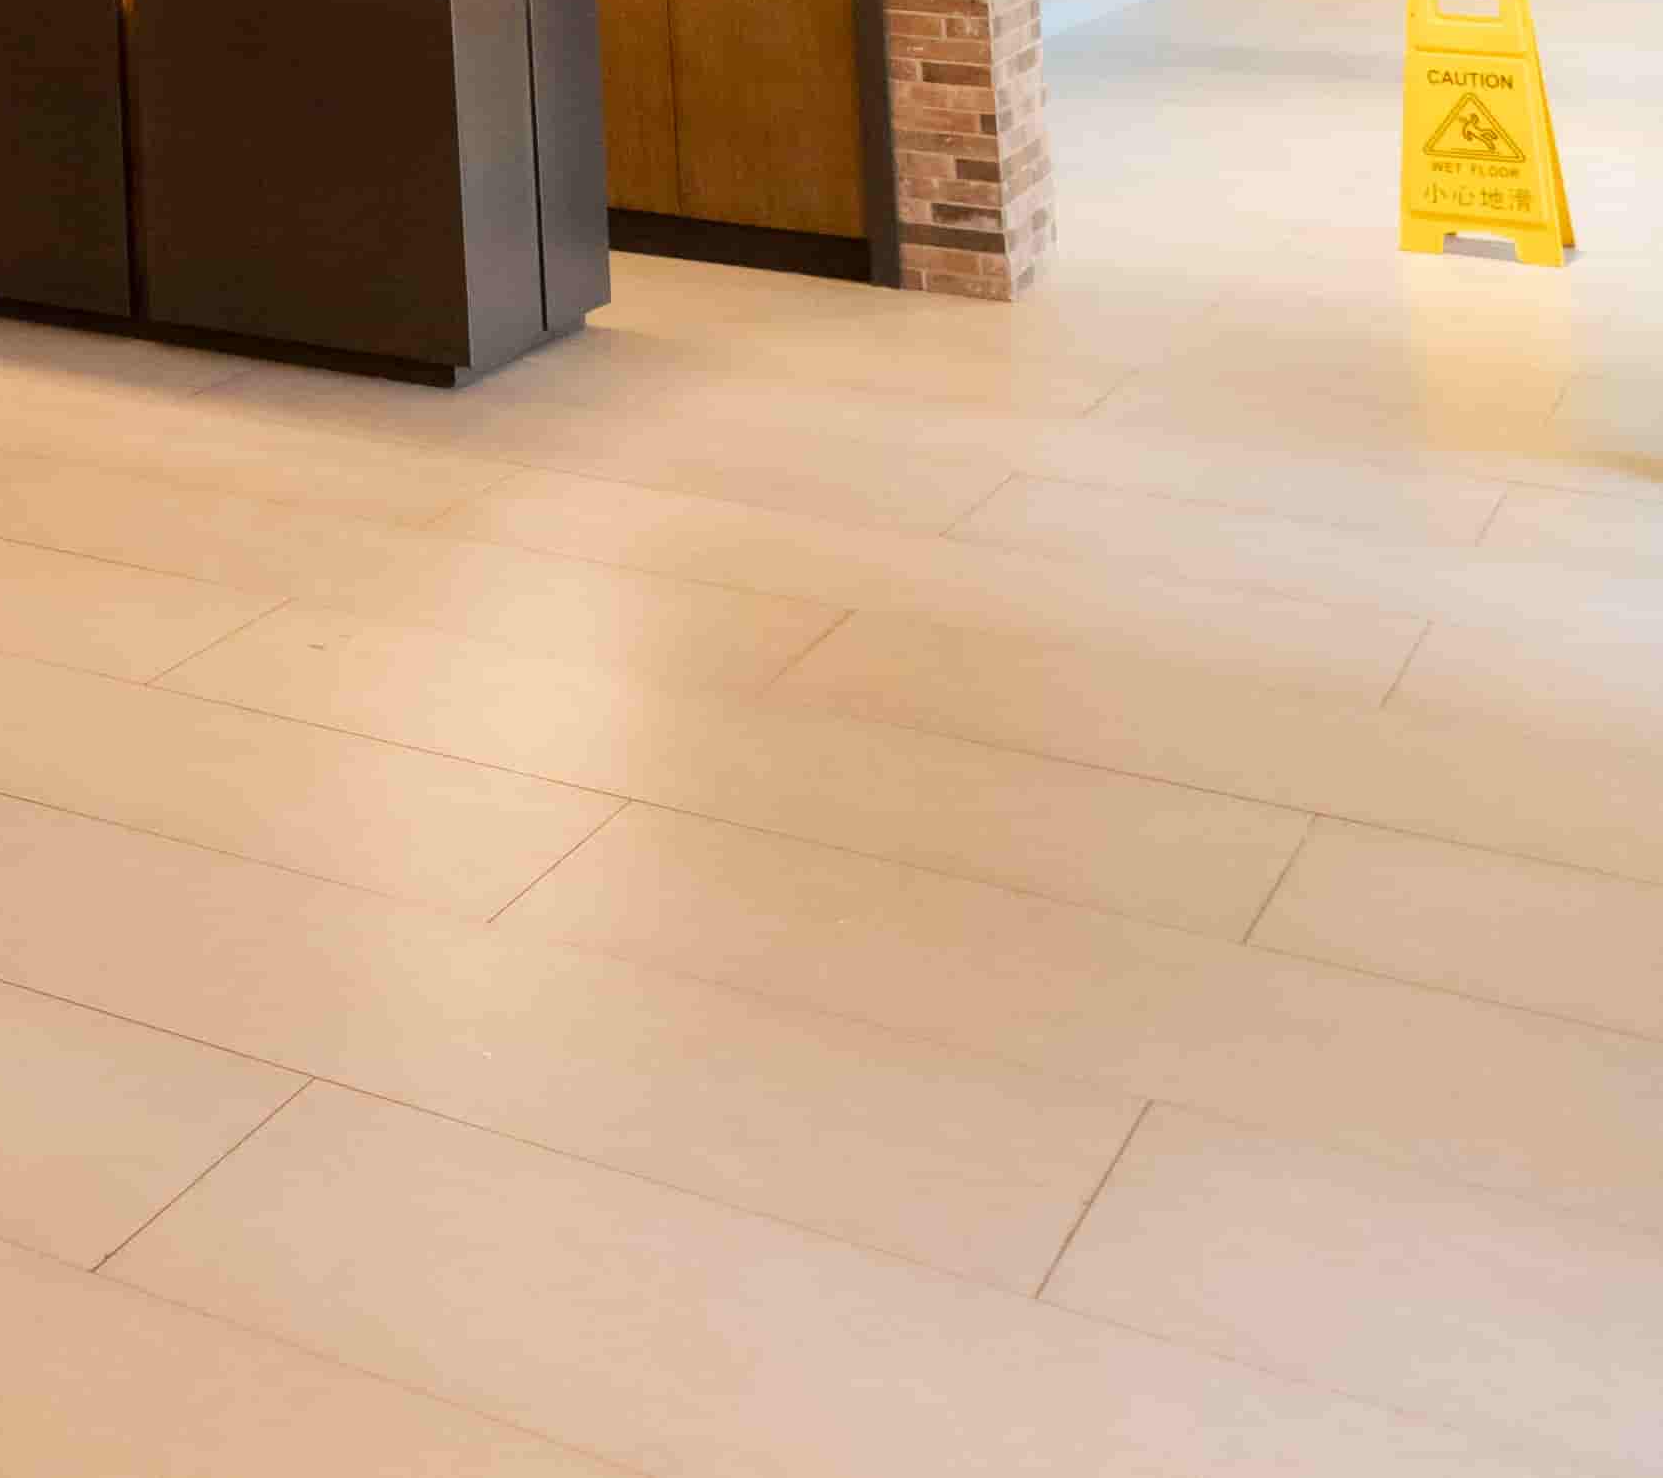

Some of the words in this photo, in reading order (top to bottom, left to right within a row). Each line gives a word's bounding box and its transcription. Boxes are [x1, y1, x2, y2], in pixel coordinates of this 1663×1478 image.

[1426, 68, 1514, 90] CAUTION
[1432, 161, 1461, 175] WET
[1470, 163, 1520, 179] FLOOR
